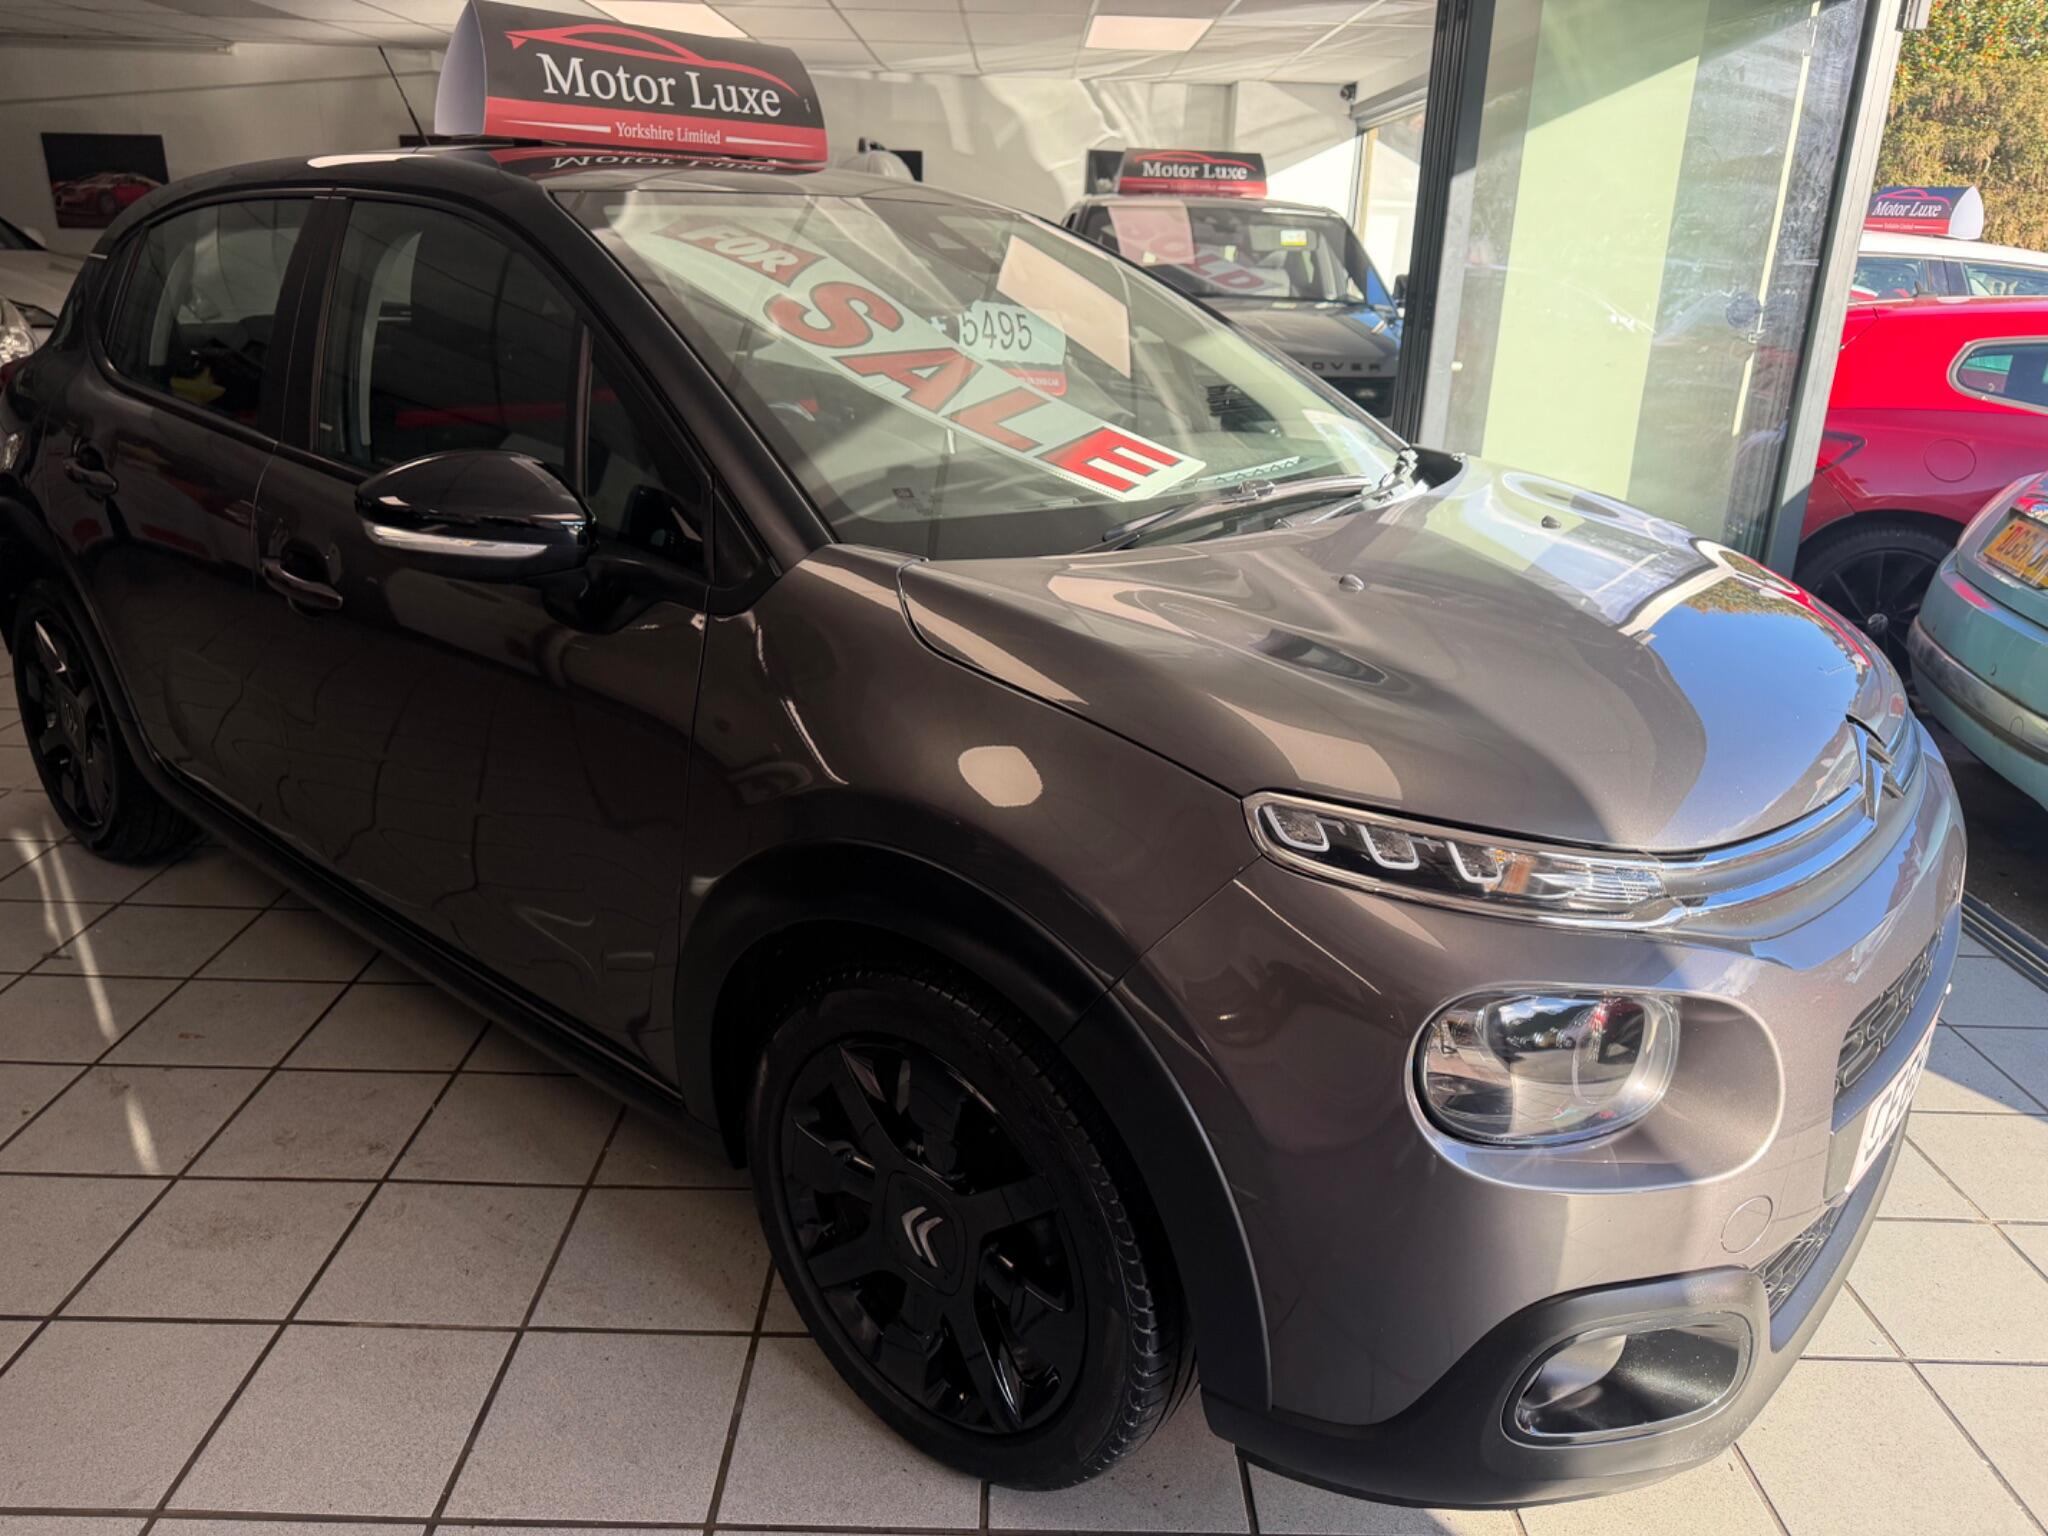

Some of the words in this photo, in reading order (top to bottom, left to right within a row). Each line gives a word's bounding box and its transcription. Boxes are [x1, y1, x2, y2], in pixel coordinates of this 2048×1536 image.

[536, 53, 676, 106] Motor
[685, 71, 781, 117] Luxe
[615, 122, 675, 142] Yorkshire
[677, 127, 720, 145] Limited
[1142, 161, 1199, 178] Motor
[1203, 163, 1248, 180] Luxe
[1872, 201, 1910, 216] Motor
[1909, 202, 1942, 217] Luxe
[675, 223, 800, 274] FOR
[1300, 362, 1381, 371] OVER
[763, 281, 1184, 494] SALE
